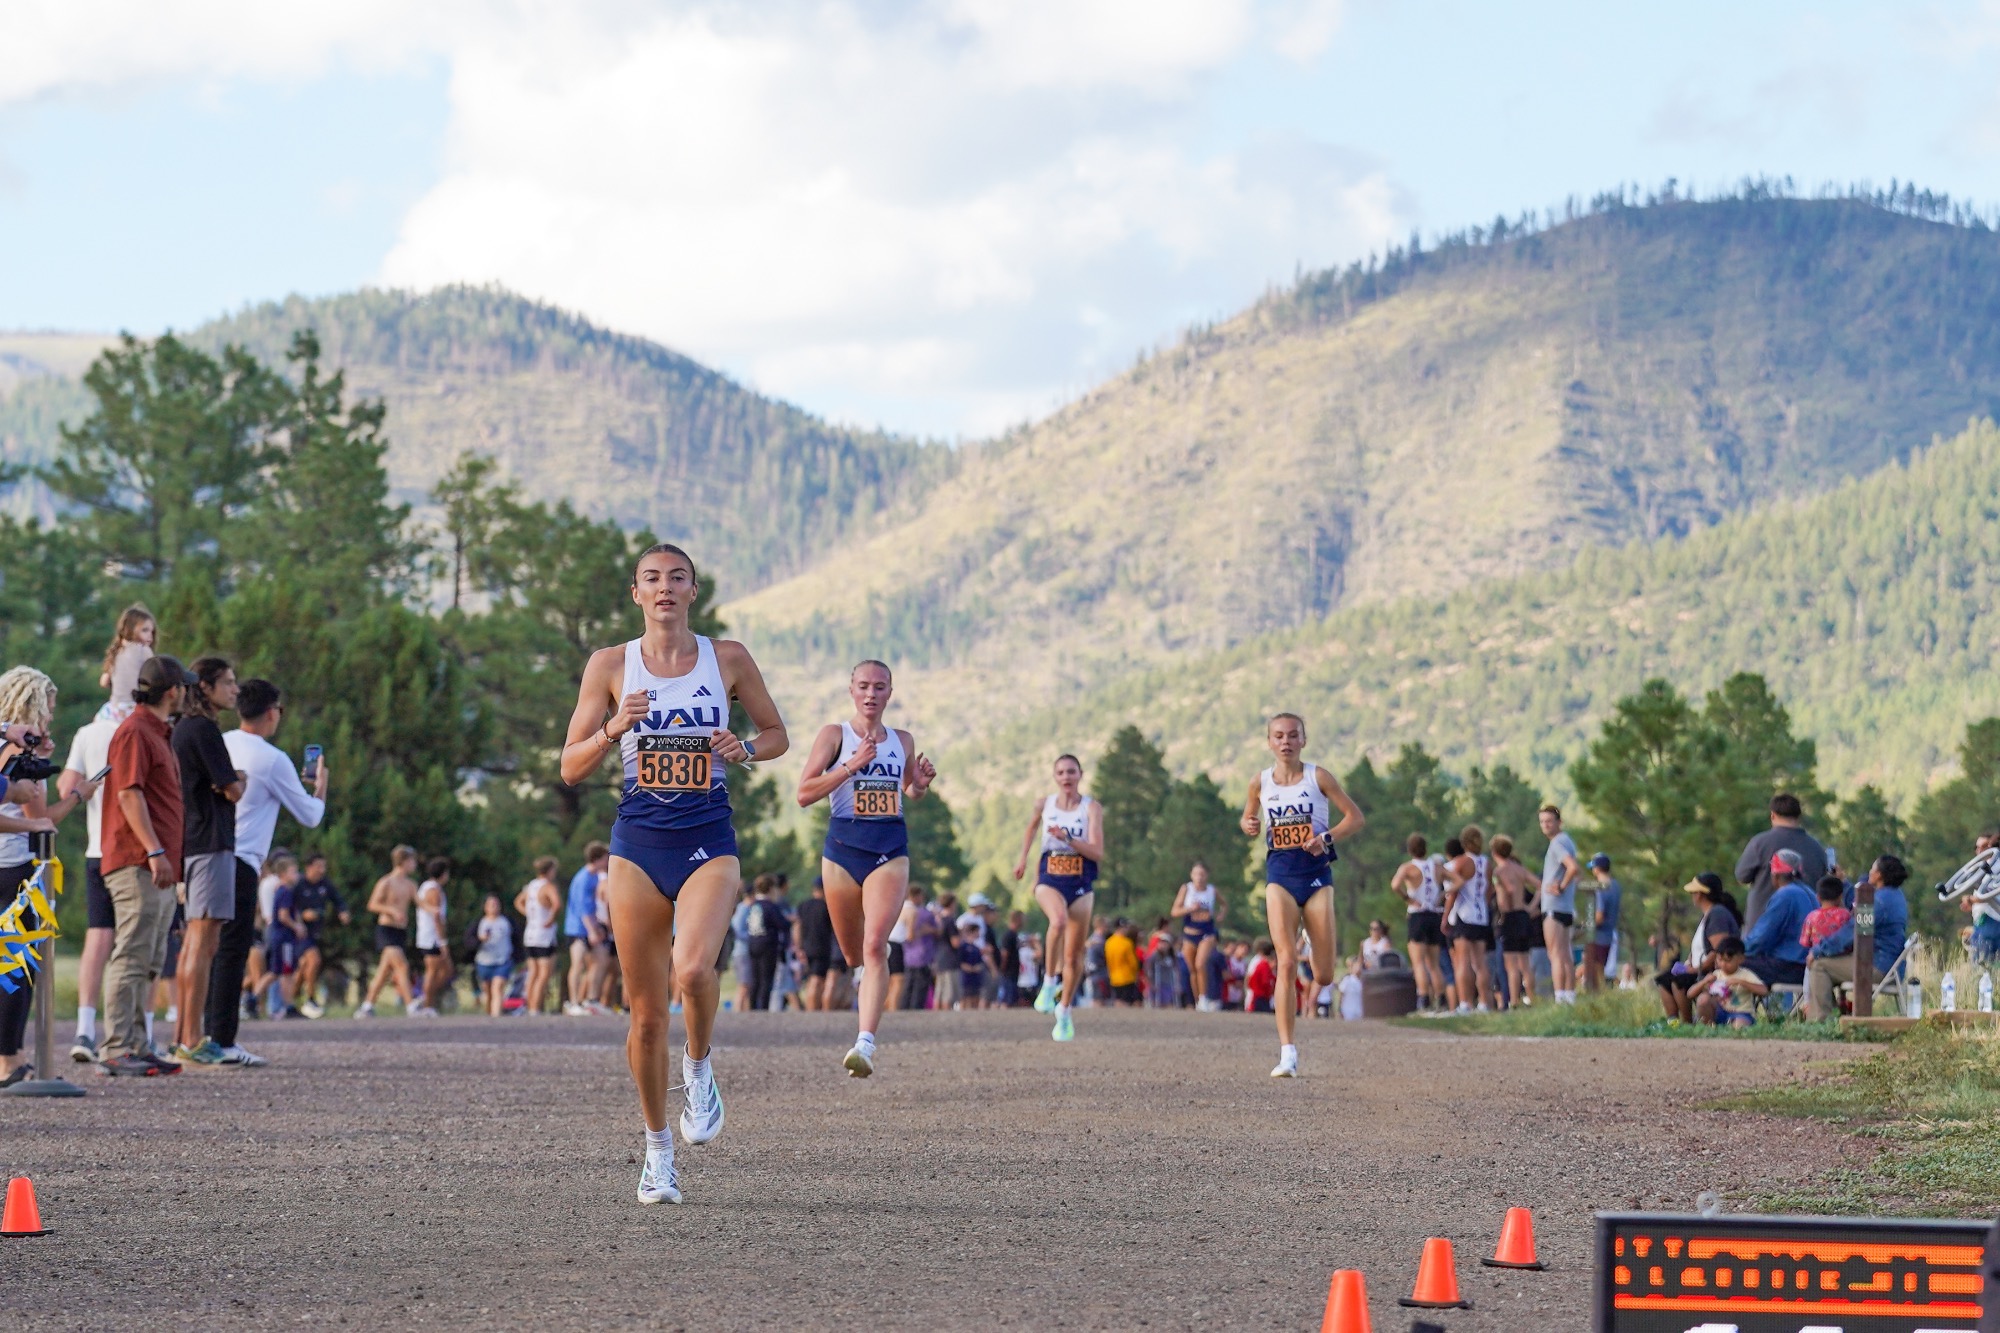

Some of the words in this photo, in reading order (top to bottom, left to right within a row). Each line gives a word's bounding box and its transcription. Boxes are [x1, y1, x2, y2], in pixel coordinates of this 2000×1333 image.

[633, 707, 720, 733] NAU
[656, 737, 704, 746] WINGFOOT
[641, 753, 707, 786] 5830
[856, 792, 897, 813] 5831
[1267, 802, 1314, 819] NAU
[1273, 825, 1311, 846] 5832
[1856, 913, 1874, 925] 0.00
